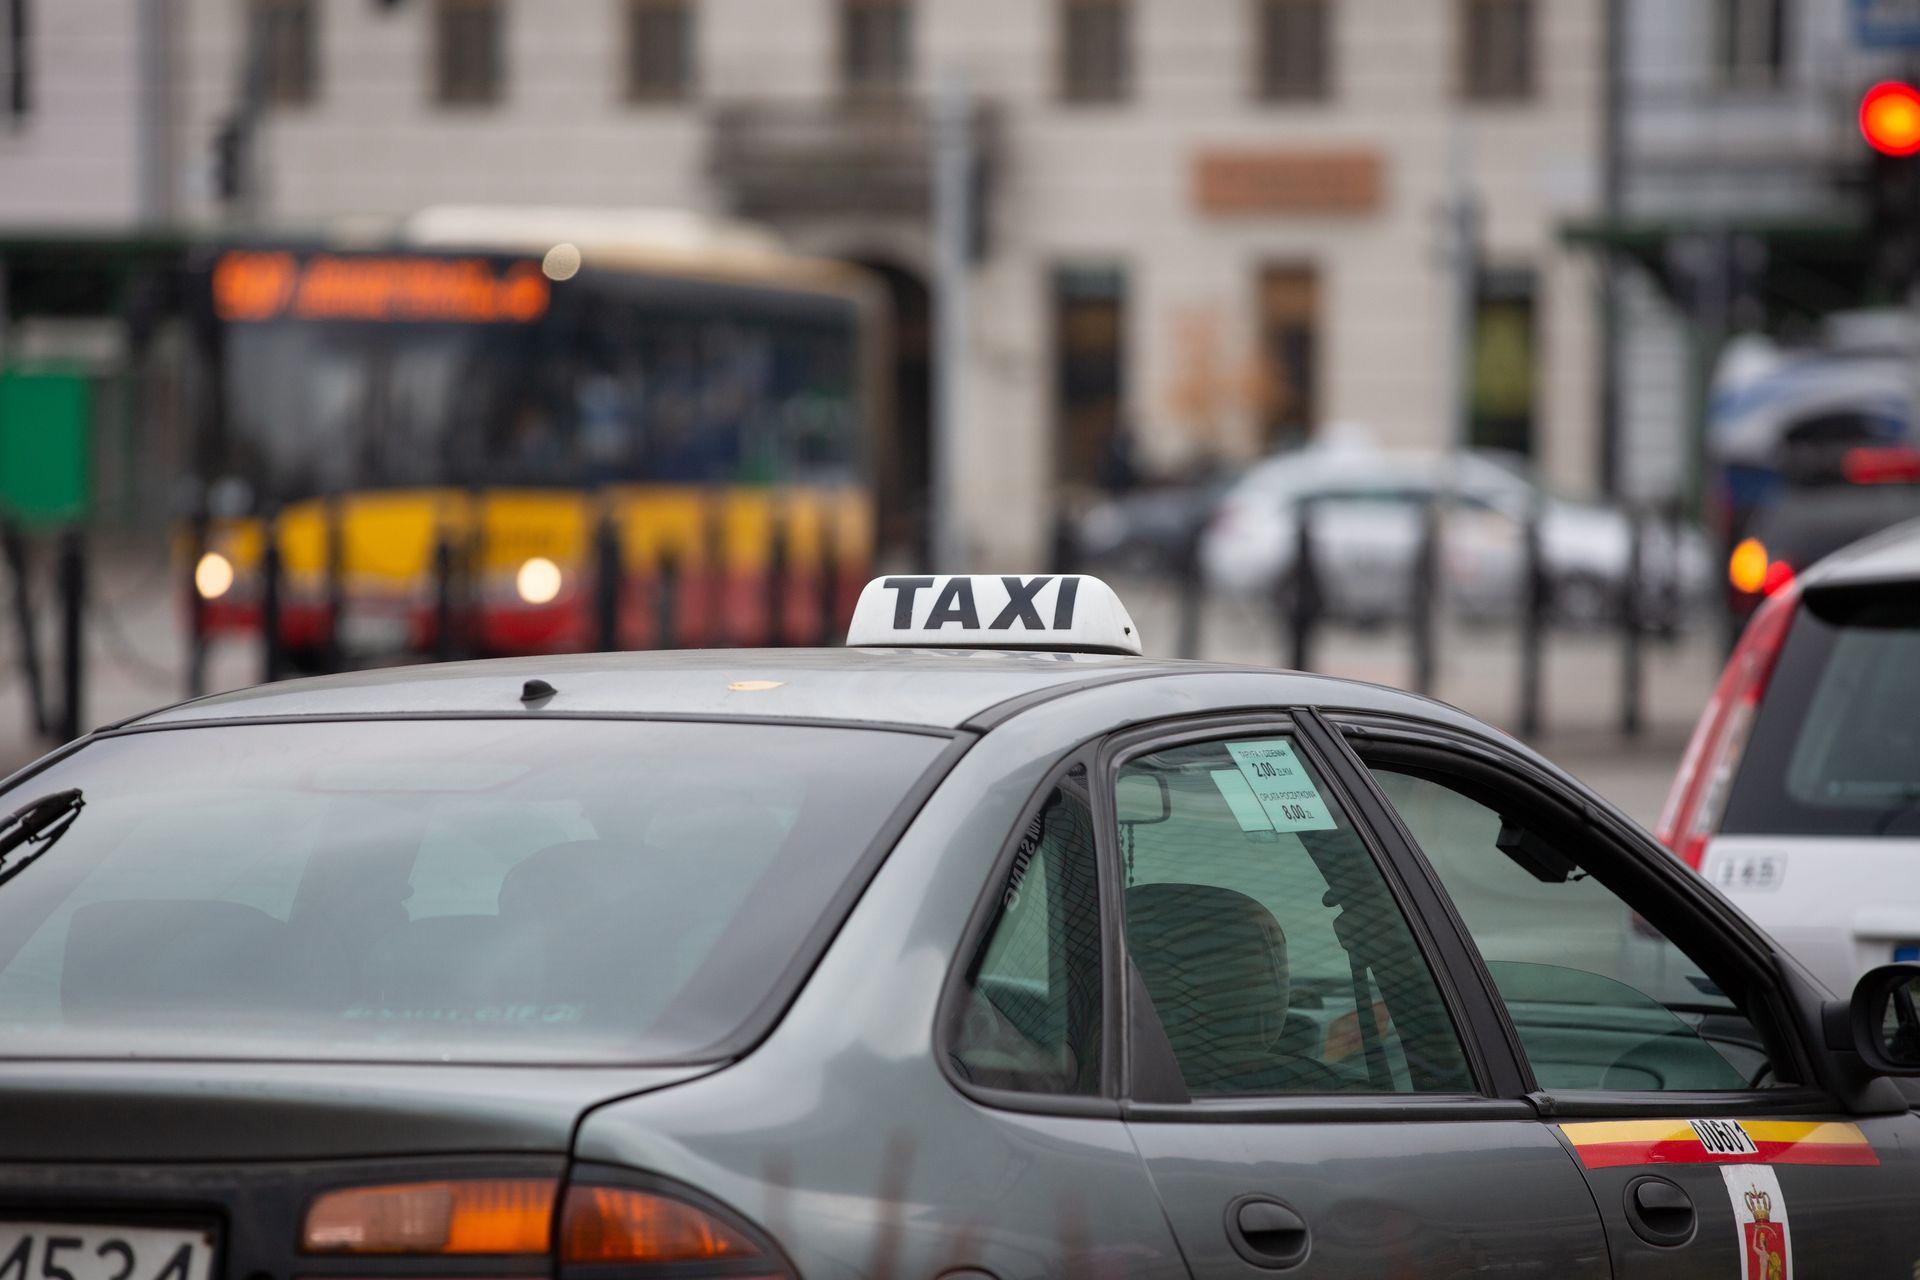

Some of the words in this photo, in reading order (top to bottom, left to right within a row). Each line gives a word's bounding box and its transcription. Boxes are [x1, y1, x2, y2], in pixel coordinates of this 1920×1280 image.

[883, 577, 1080, 630] TAXI
[1252, 762, 1277, 780] 2,00
[1282, 804, 1306, 822] 8,00
[1690, 1120, 1757, 1153] 00601
